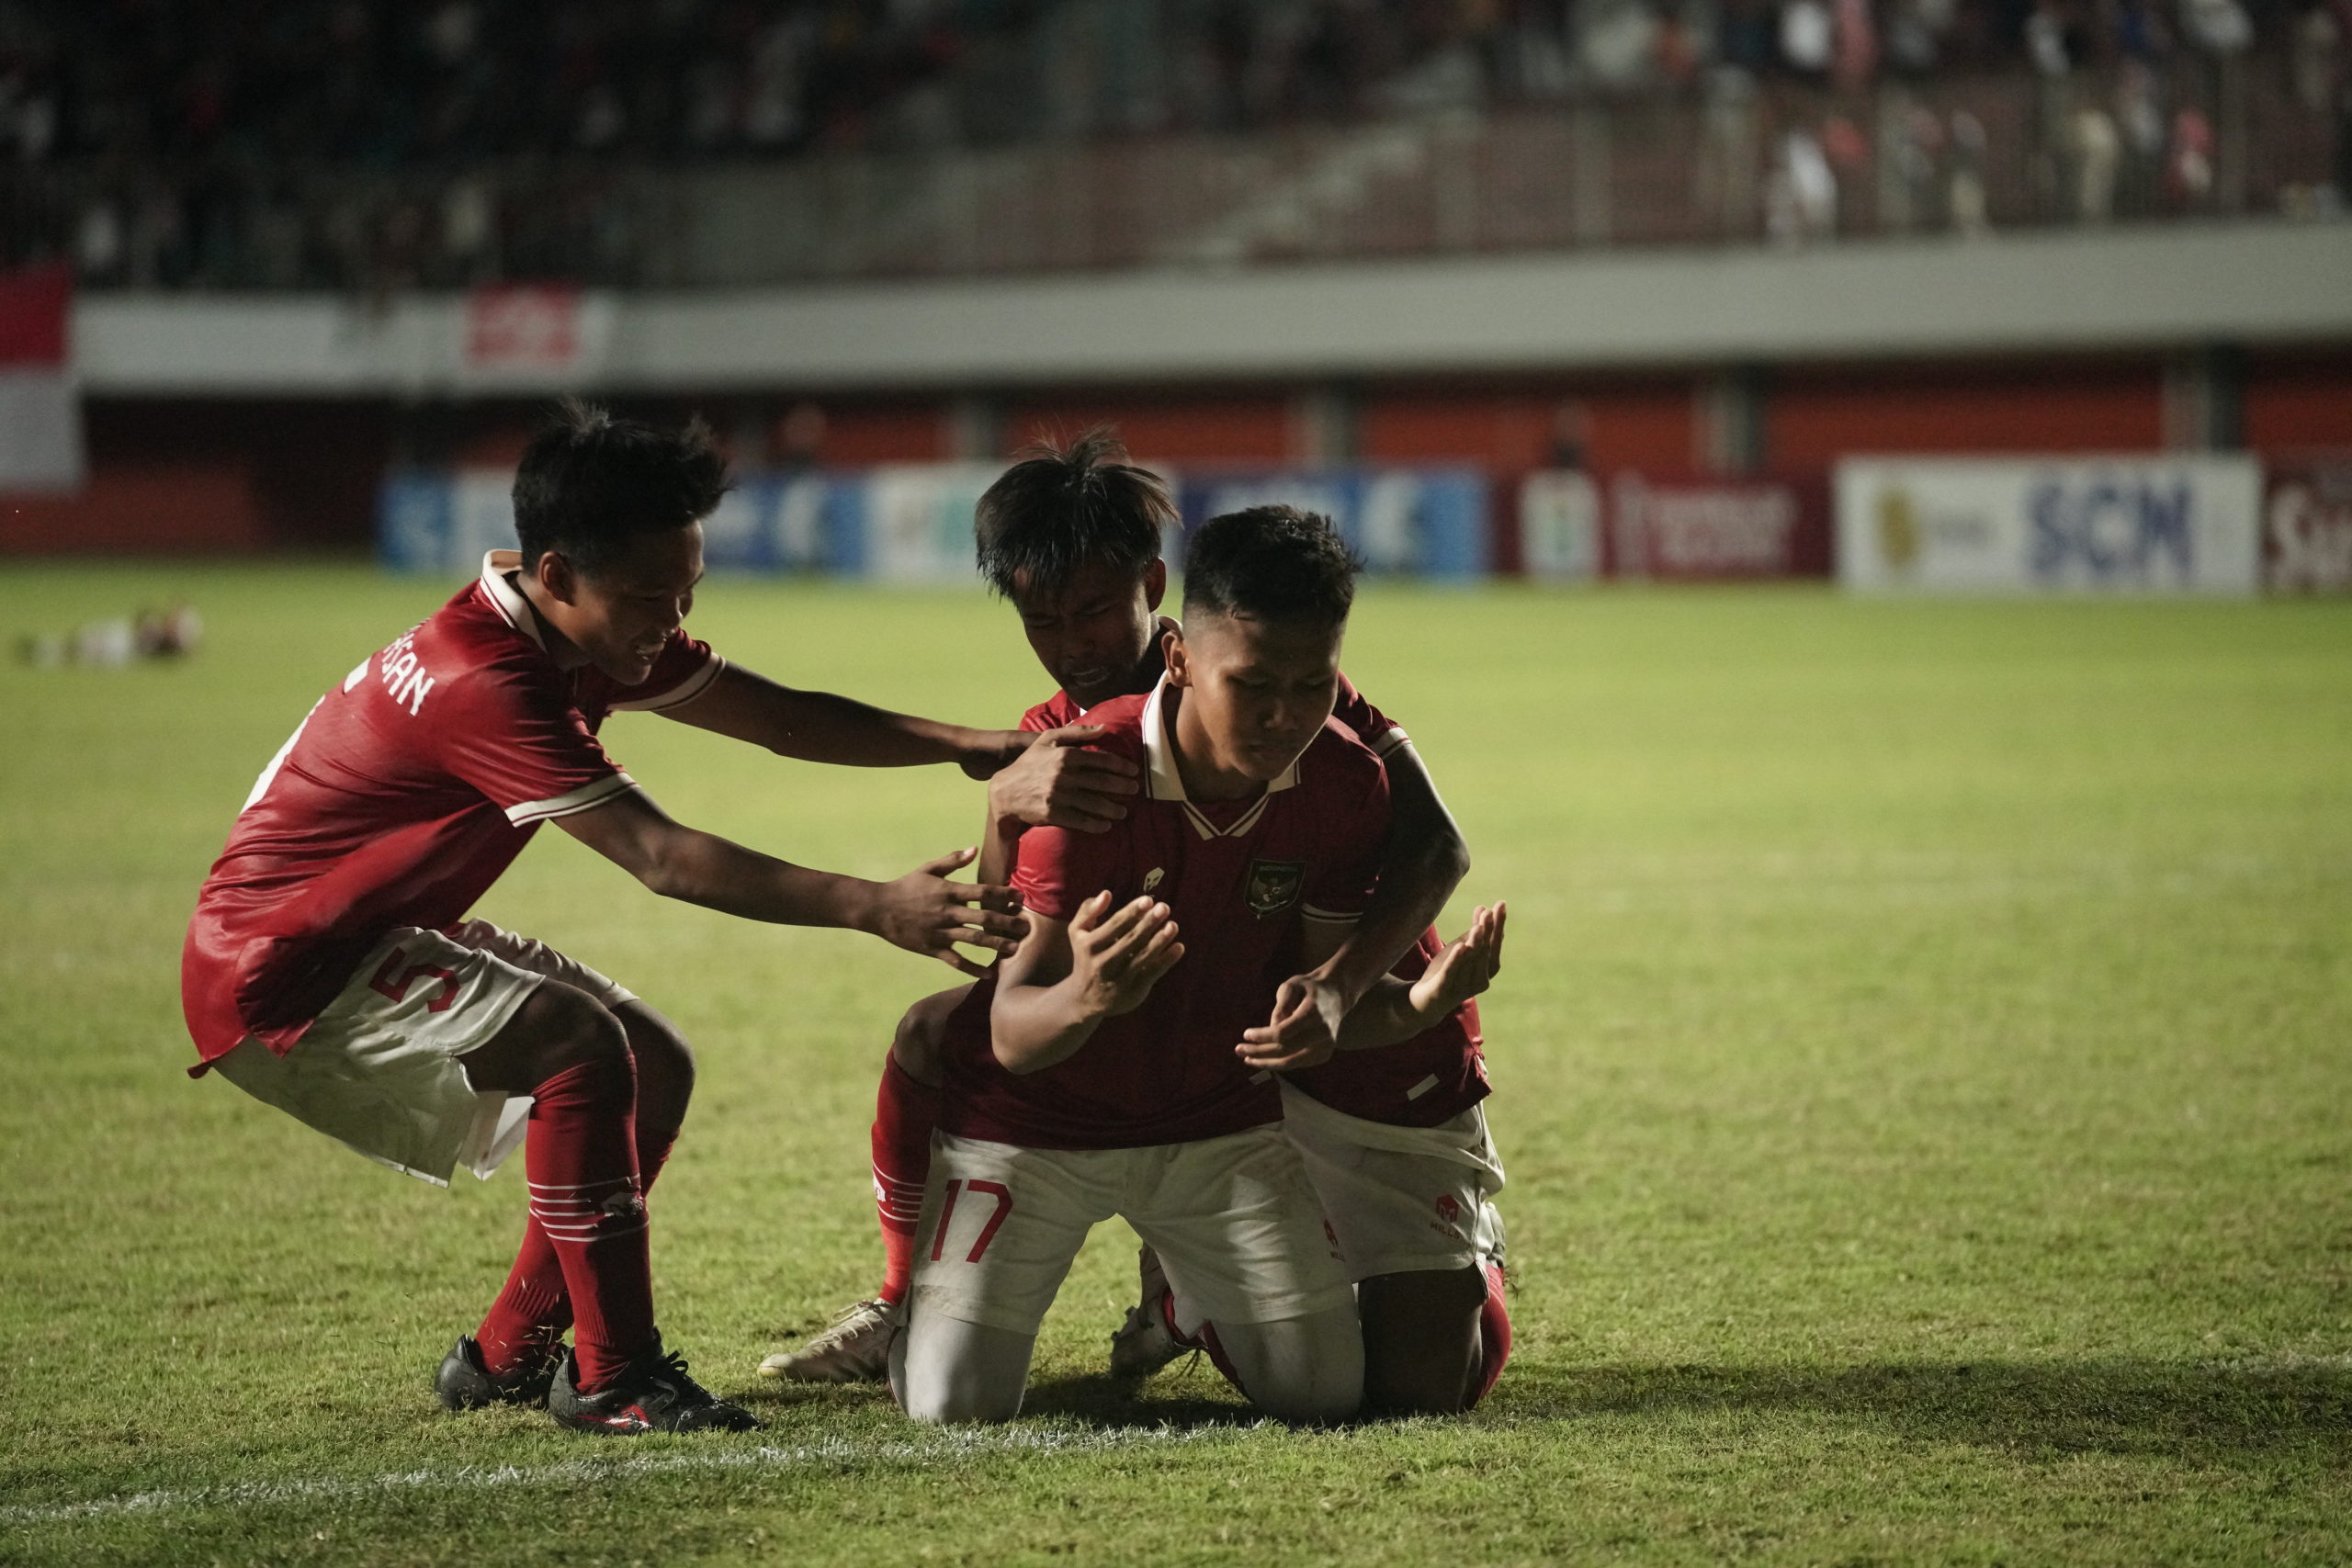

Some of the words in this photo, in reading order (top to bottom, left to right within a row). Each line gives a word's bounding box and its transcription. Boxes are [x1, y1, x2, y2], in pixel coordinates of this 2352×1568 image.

[368, 946, 461, 1013] 5
[930, 1179, 1013, 1264] 17
[1430, 1221, 1461, 1240] MILLS
